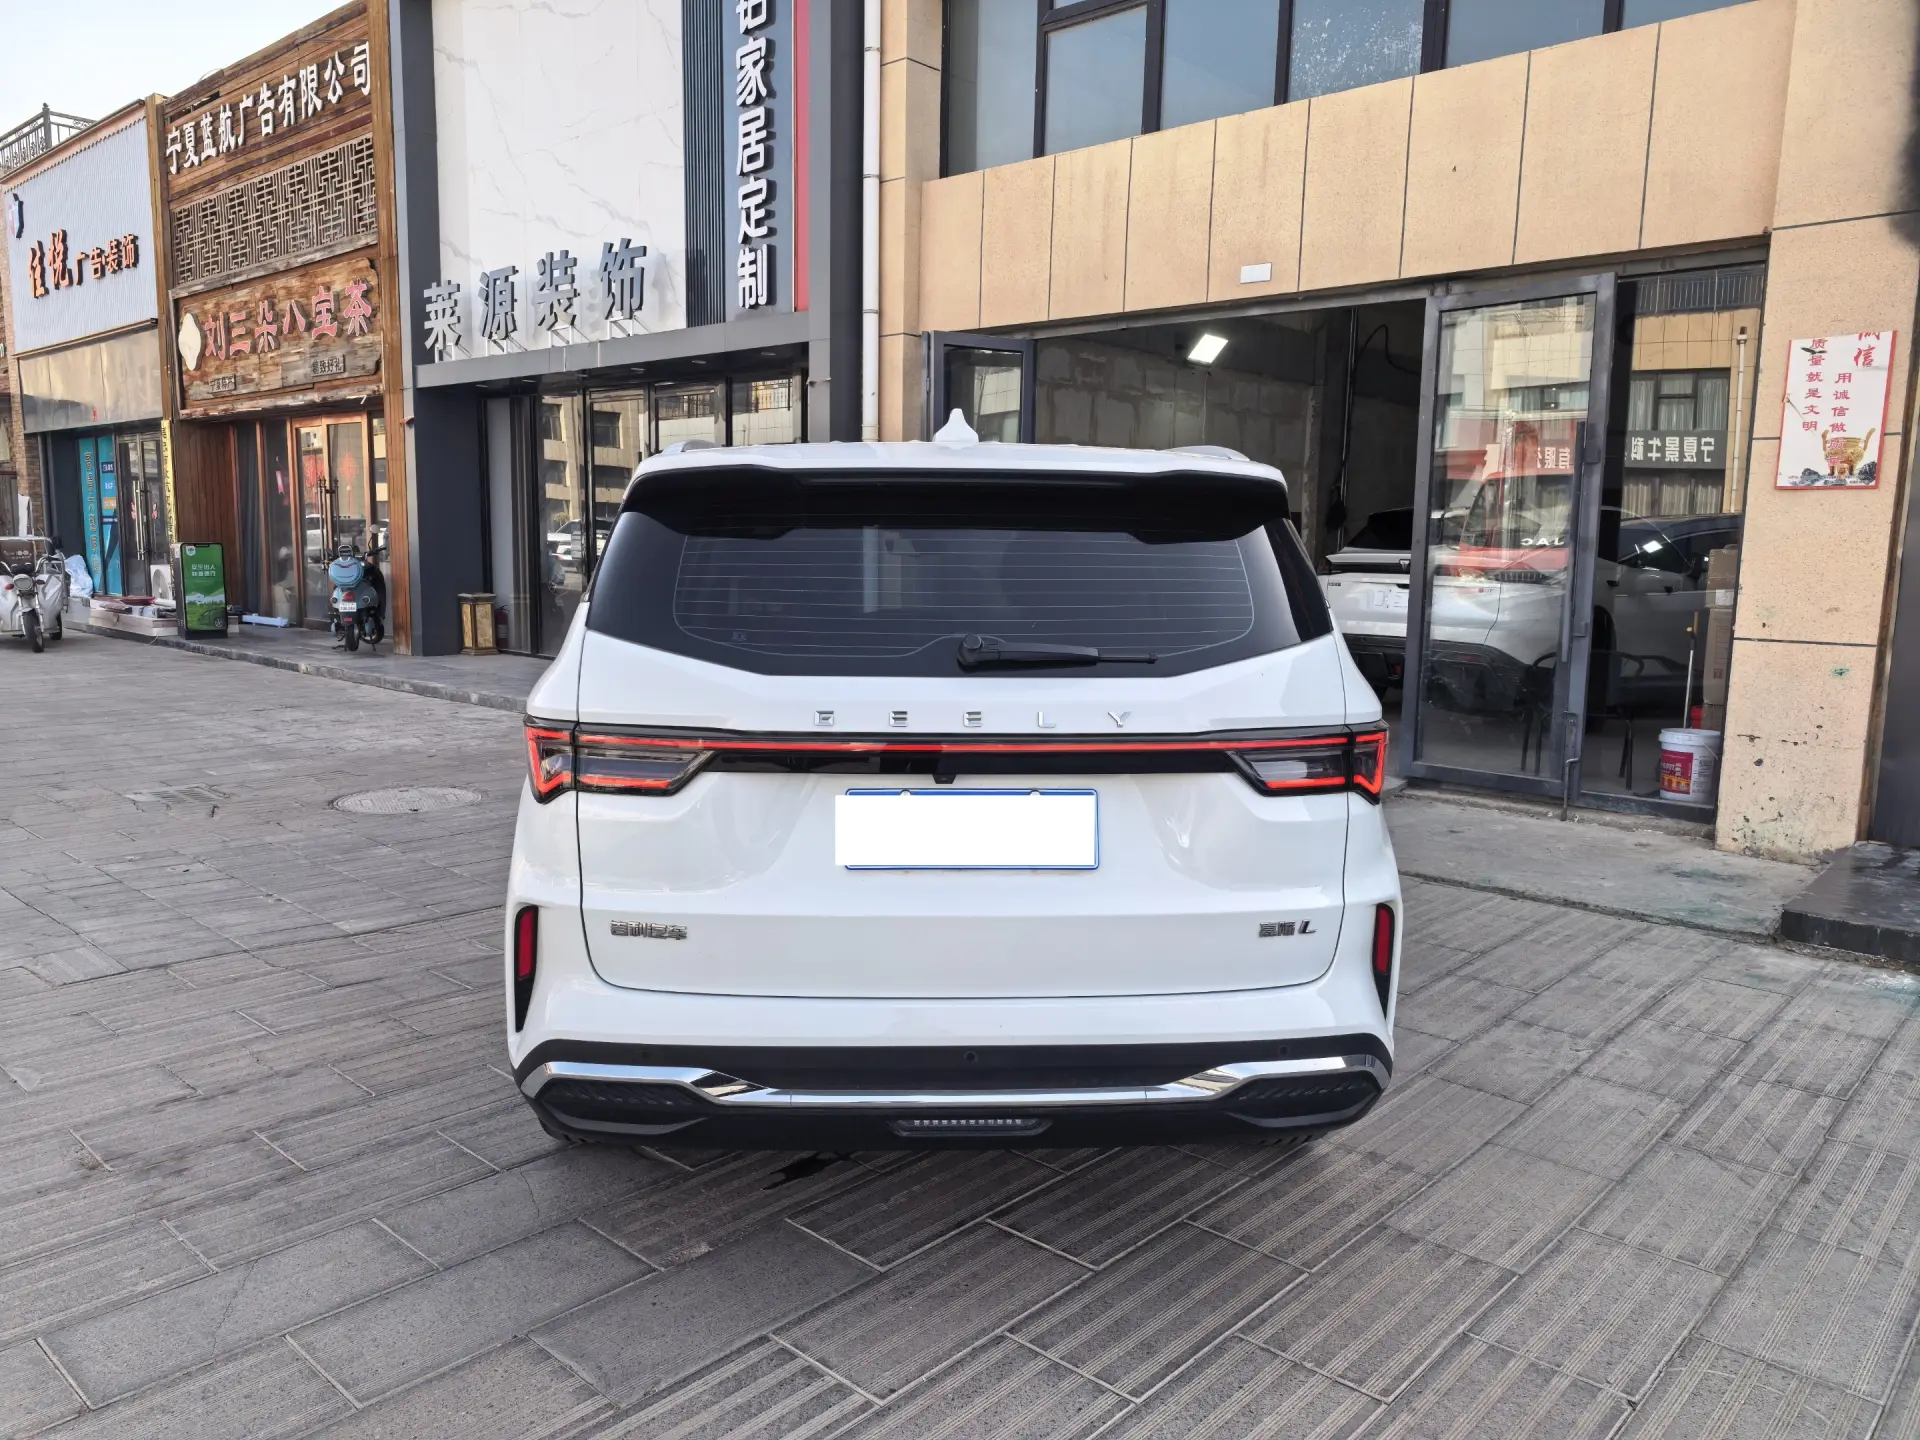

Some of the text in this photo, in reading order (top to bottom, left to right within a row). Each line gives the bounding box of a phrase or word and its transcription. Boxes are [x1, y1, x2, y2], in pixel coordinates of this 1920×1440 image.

[166, 41, 371, 175] 宁夏蓝航广告有限公司
[204, 279, 372, 360] 刘三朵八宝茶
[423, 238, 647, 351] 莱源装饰
[1802, 338, 1828, 431] 质量就是文明
[1853, 332, 1881, 367] 信
[813, 710, 1133, 729] GEELY
